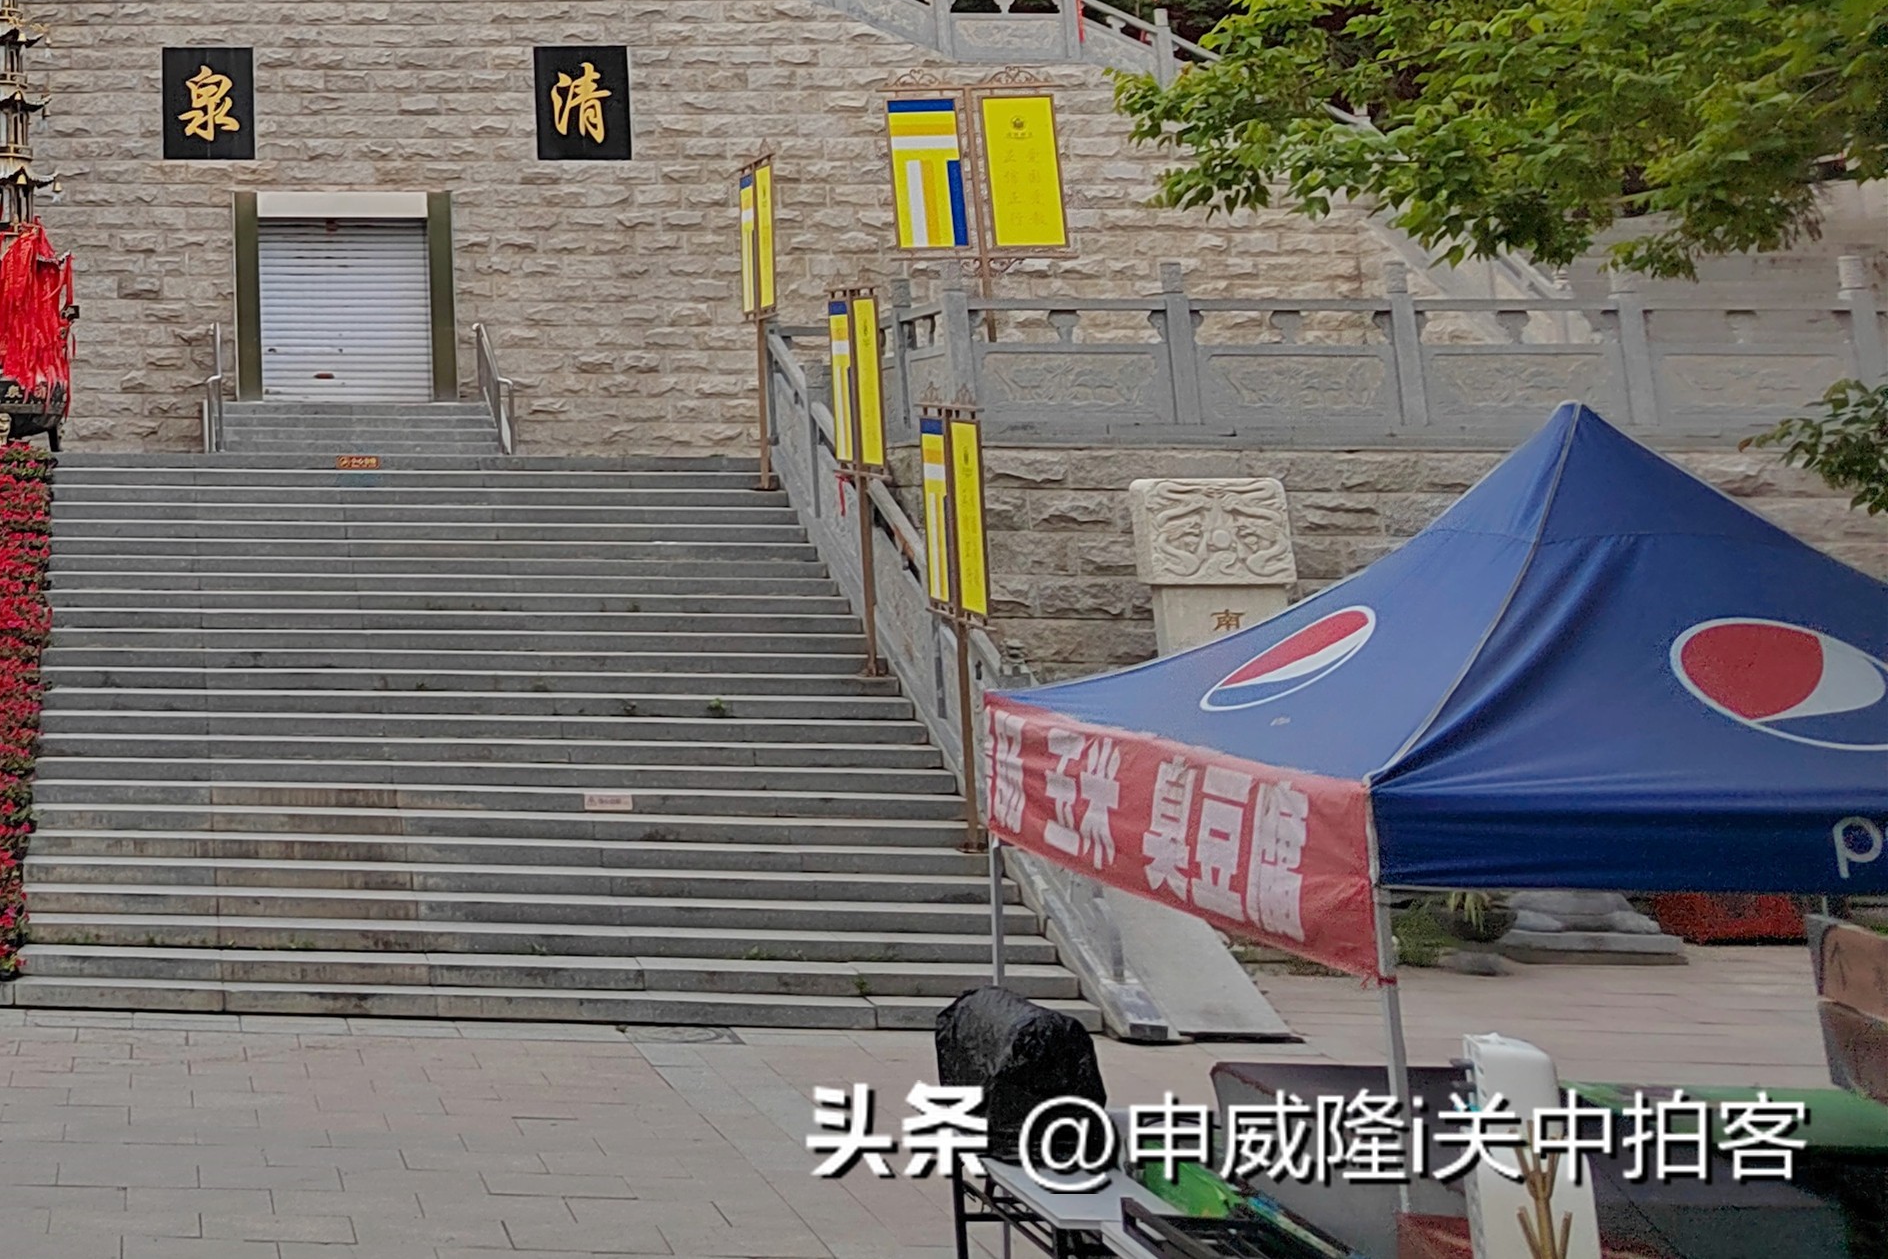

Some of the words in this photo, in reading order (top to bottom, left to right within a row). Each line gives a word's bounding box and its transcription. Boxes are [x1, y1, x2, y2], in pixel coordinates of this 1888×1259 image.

[1043, 728, 1121, 870] 玉米
[1142, 755, 1309, 942] 臭豆腐
